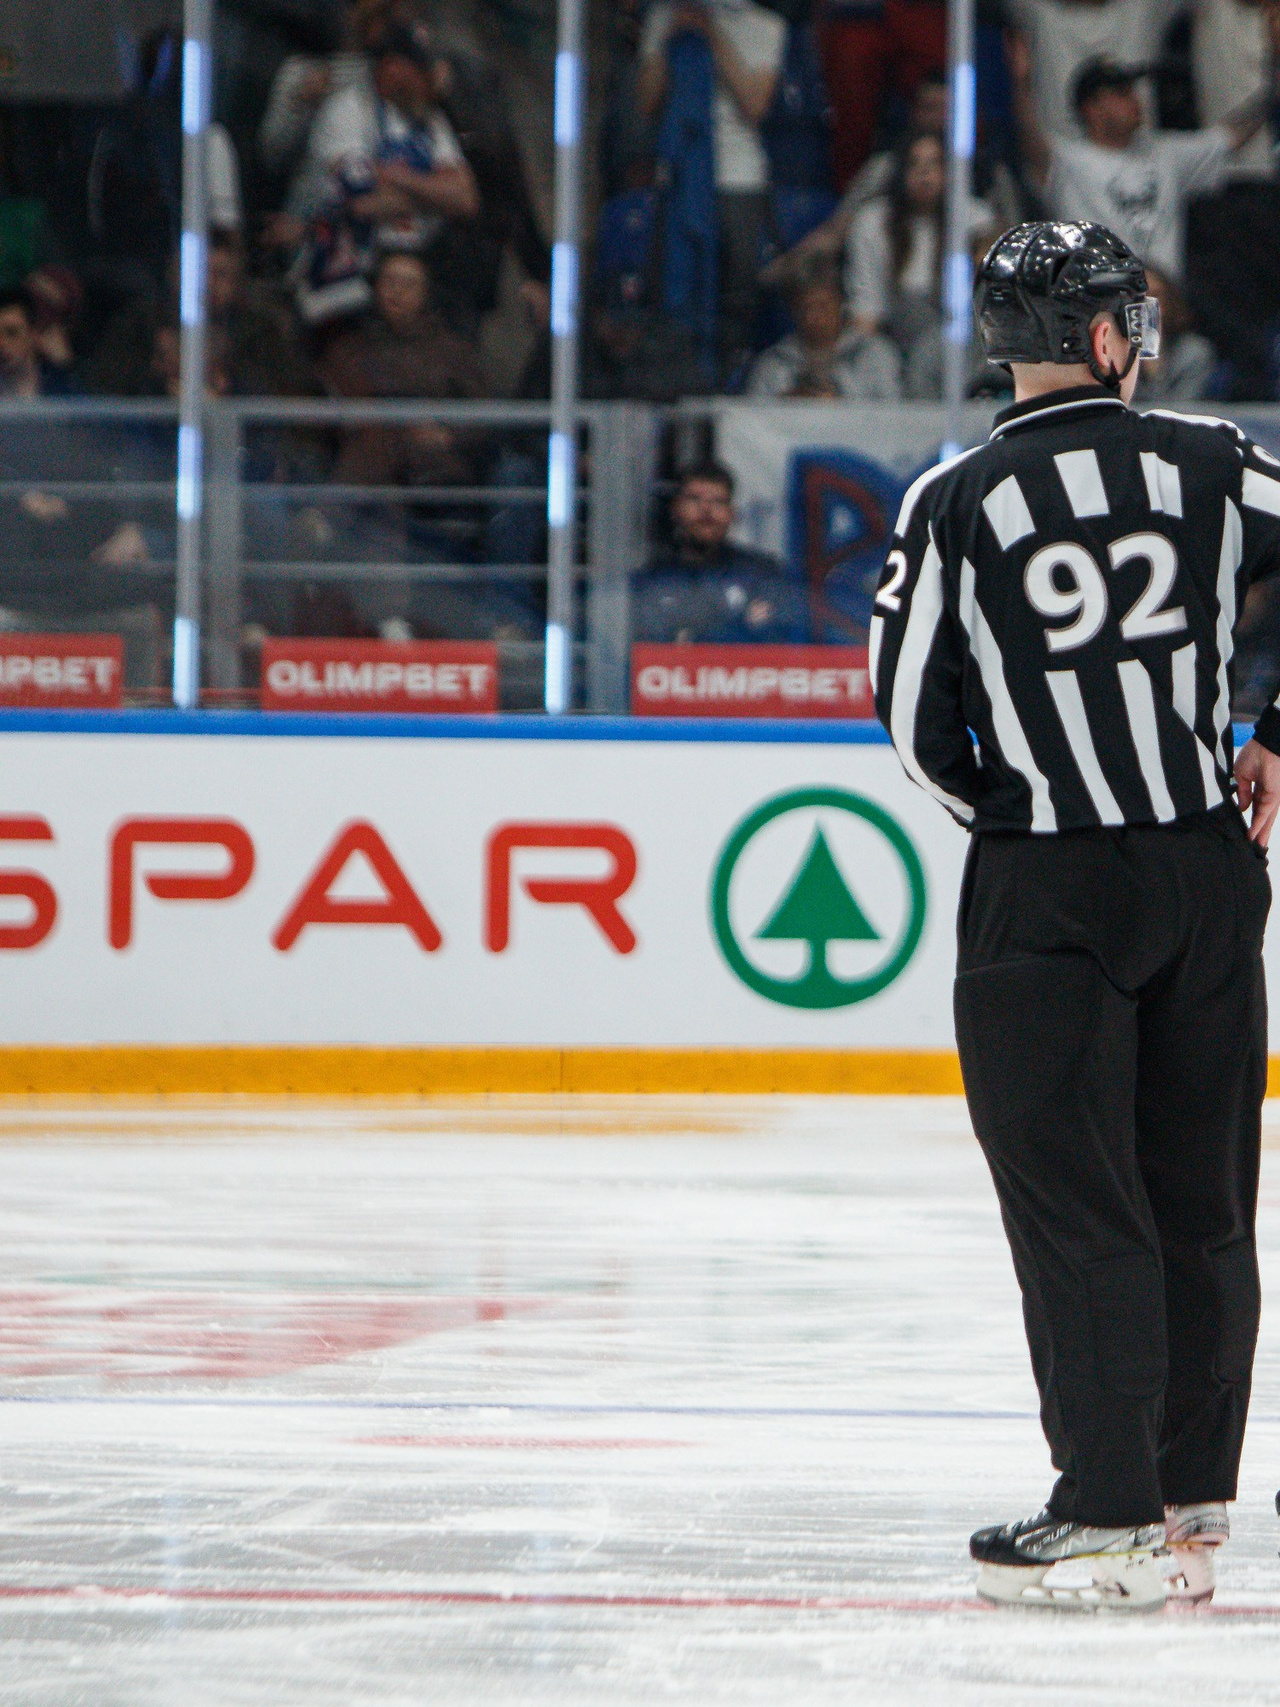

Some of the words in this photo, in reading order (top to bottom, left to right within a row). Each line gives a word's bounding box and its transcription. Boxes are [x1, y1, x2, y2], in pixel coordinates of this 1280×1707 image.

[875, 549, 908, 612] 2
[1022, 530, 1189, 655] 92
[0, 655, 114, 693] PBET
[266, 659, 491, 699] OLIMPBET
[636, 665, 870, 702] OLIMPBET
